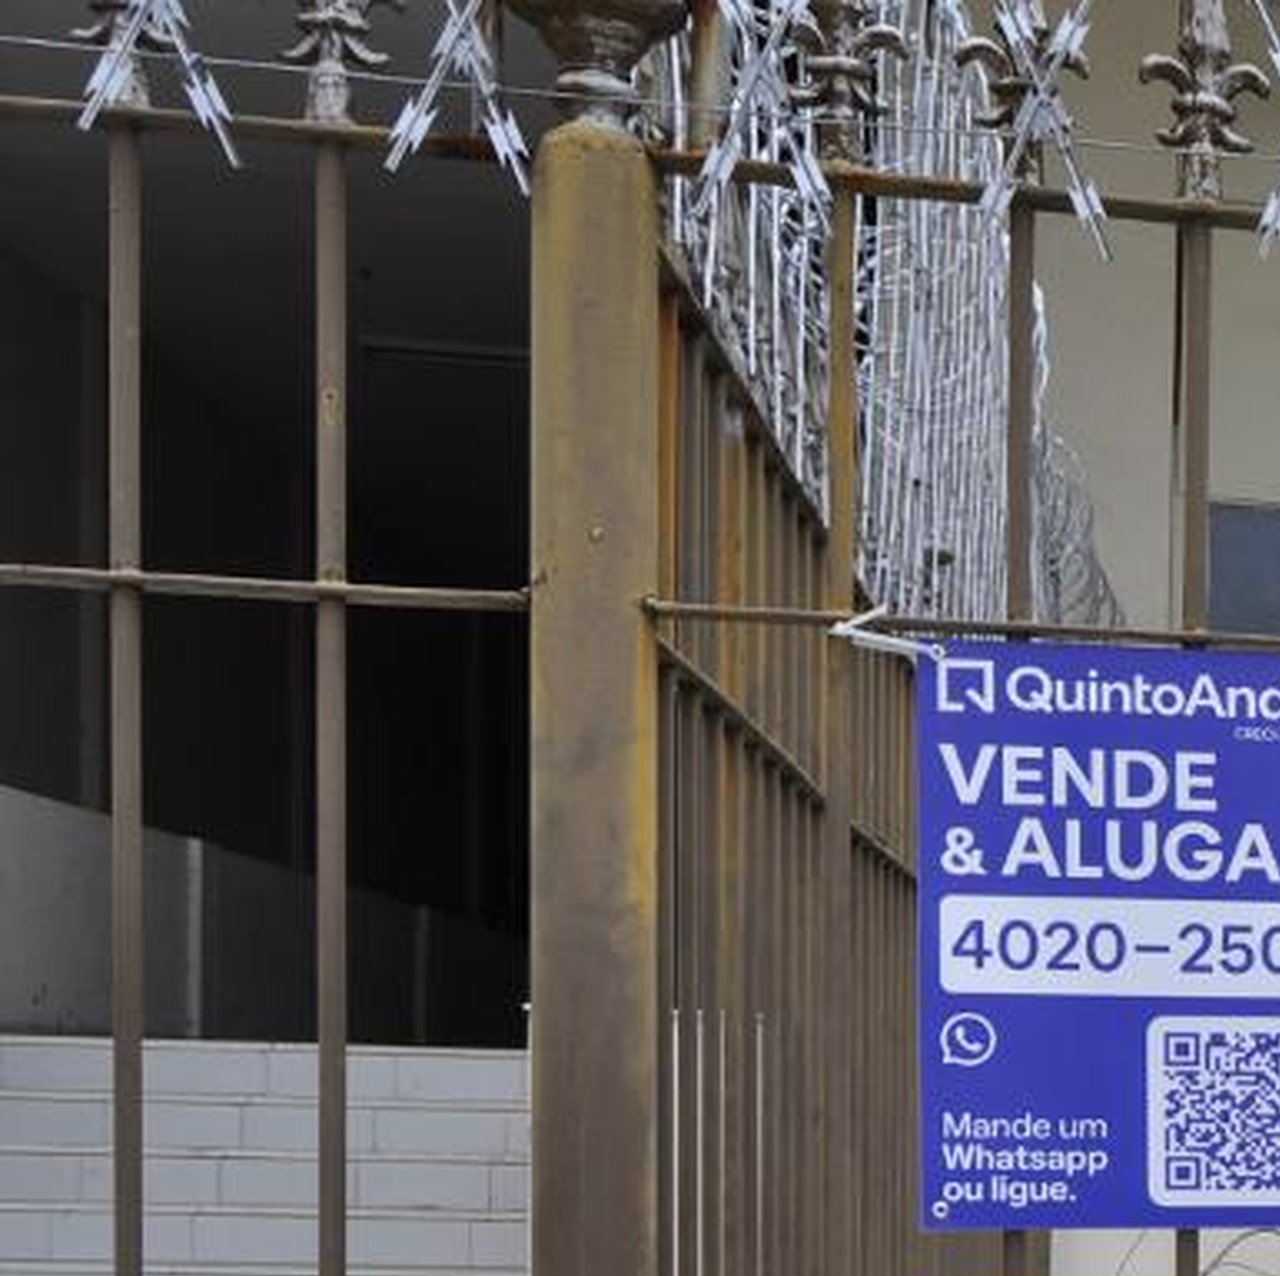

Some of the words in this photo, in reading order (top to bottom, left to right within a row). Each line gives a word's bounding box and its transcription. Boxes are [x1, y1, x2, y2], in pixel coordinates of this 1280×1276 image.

[938, 744, 1217, 812] VENDE
[941, 828, 986, 875] &
[942, 1112, 1052, 1139] Mande
[1058, 1119, 1107, 1139] um
[943, 1144, 1108, 1176] Whatsapp
[943, 1180, 985, 1202] ou
[993, 1176, 1076, 1207] ligue.
